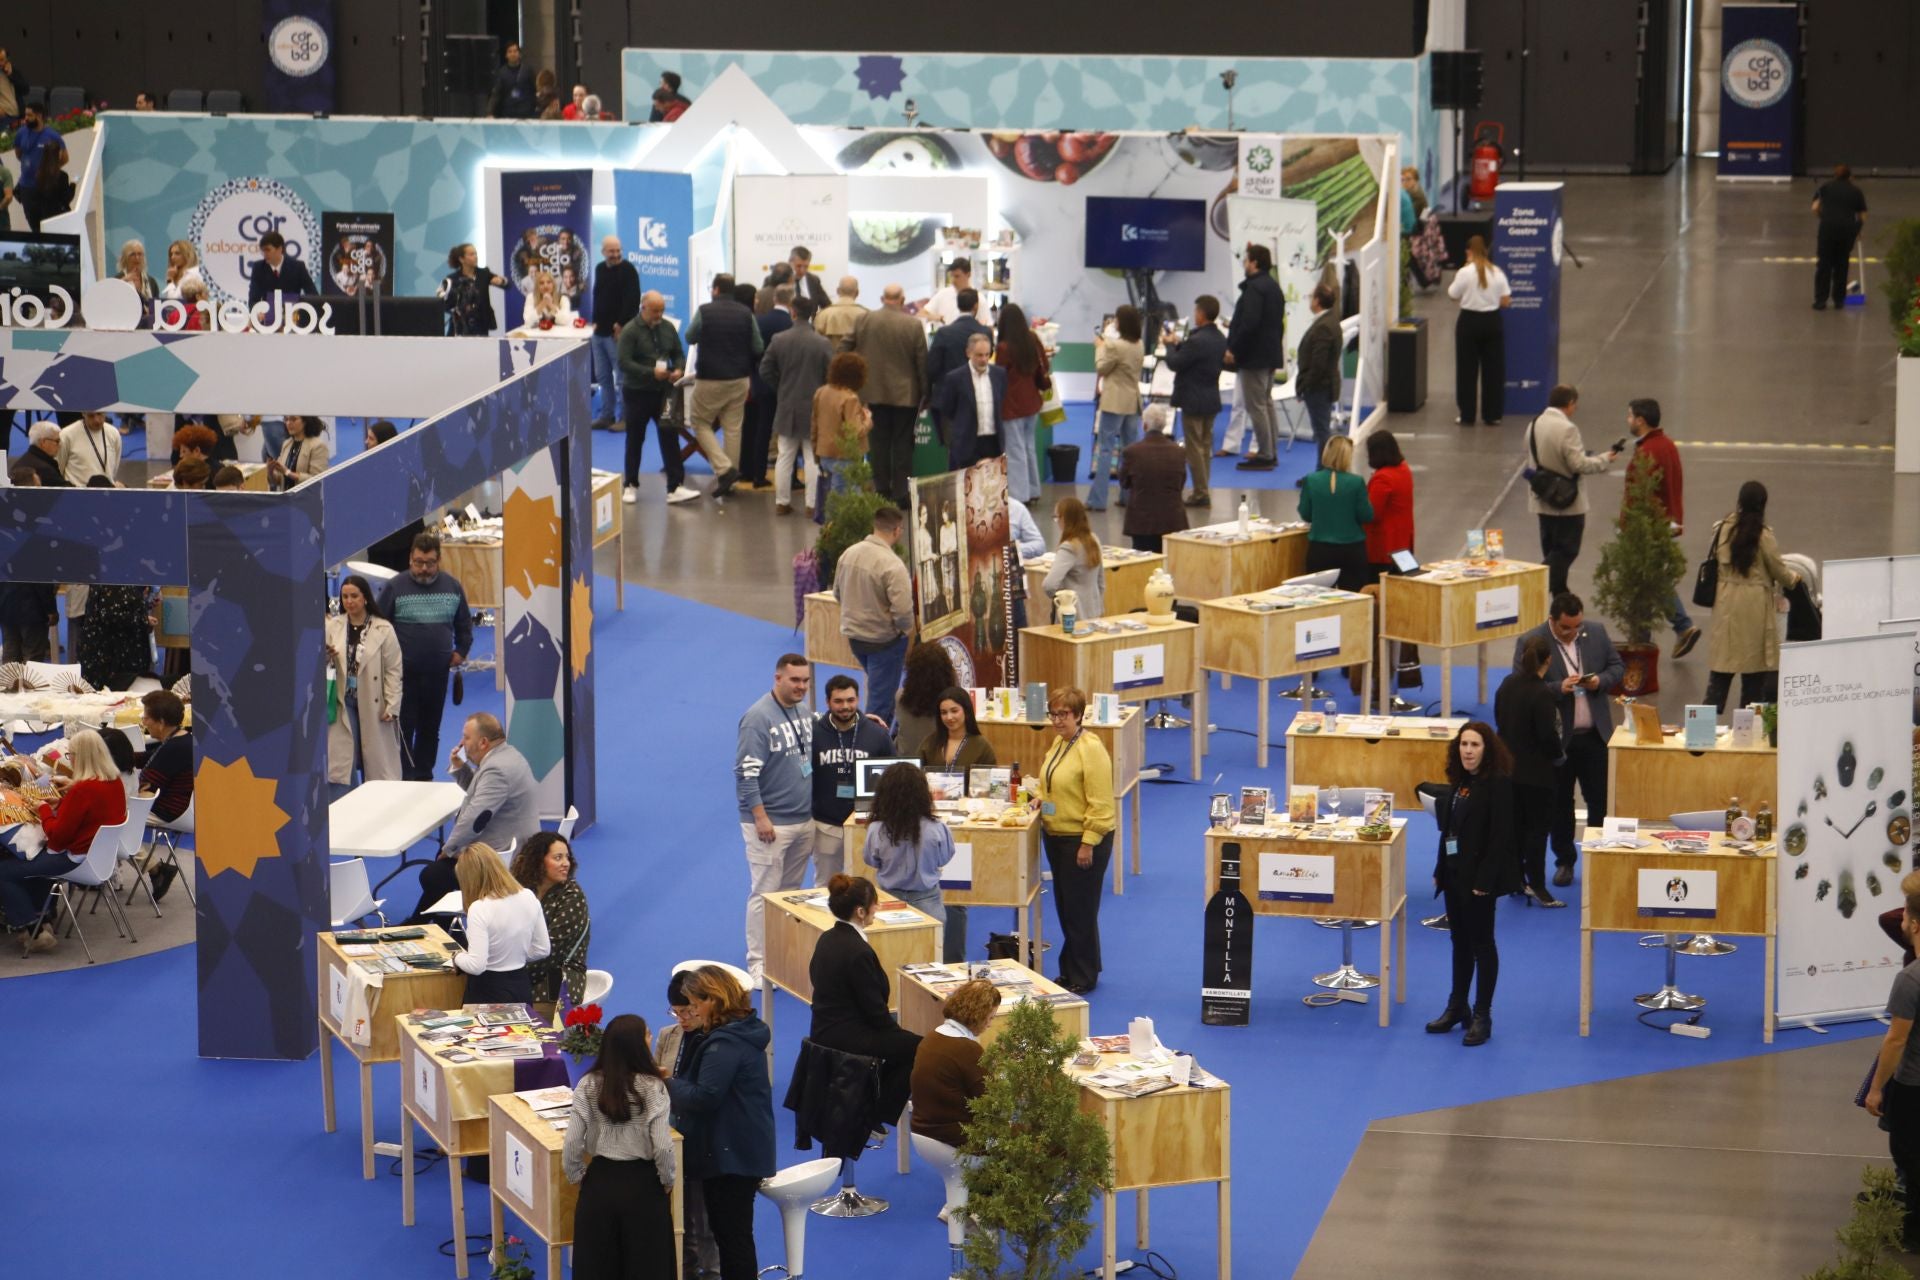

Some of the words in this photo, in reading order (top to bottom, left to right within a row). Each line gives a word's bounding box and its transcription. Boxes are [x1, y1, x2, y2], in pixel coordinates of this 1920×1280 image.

[1512, 207, 1535, 217] Zona
[1498, 217, 1549, 227] Actividades
[1508, 226, 1538, 236] Gastro
[628, 251, 679, 266] Diputación
[642, 264, 679, 278] Córdoba
[1783, 674, 1821, 689] FERIA
[1783, 688, 1798, 698] DEL
[1802, 686, 1820, 696] VINO
[1822, 685, 1832, 694] DE
[1851, 692, 1862, 701] DE
[1223, 897, 1235, 983] MONTILLA
